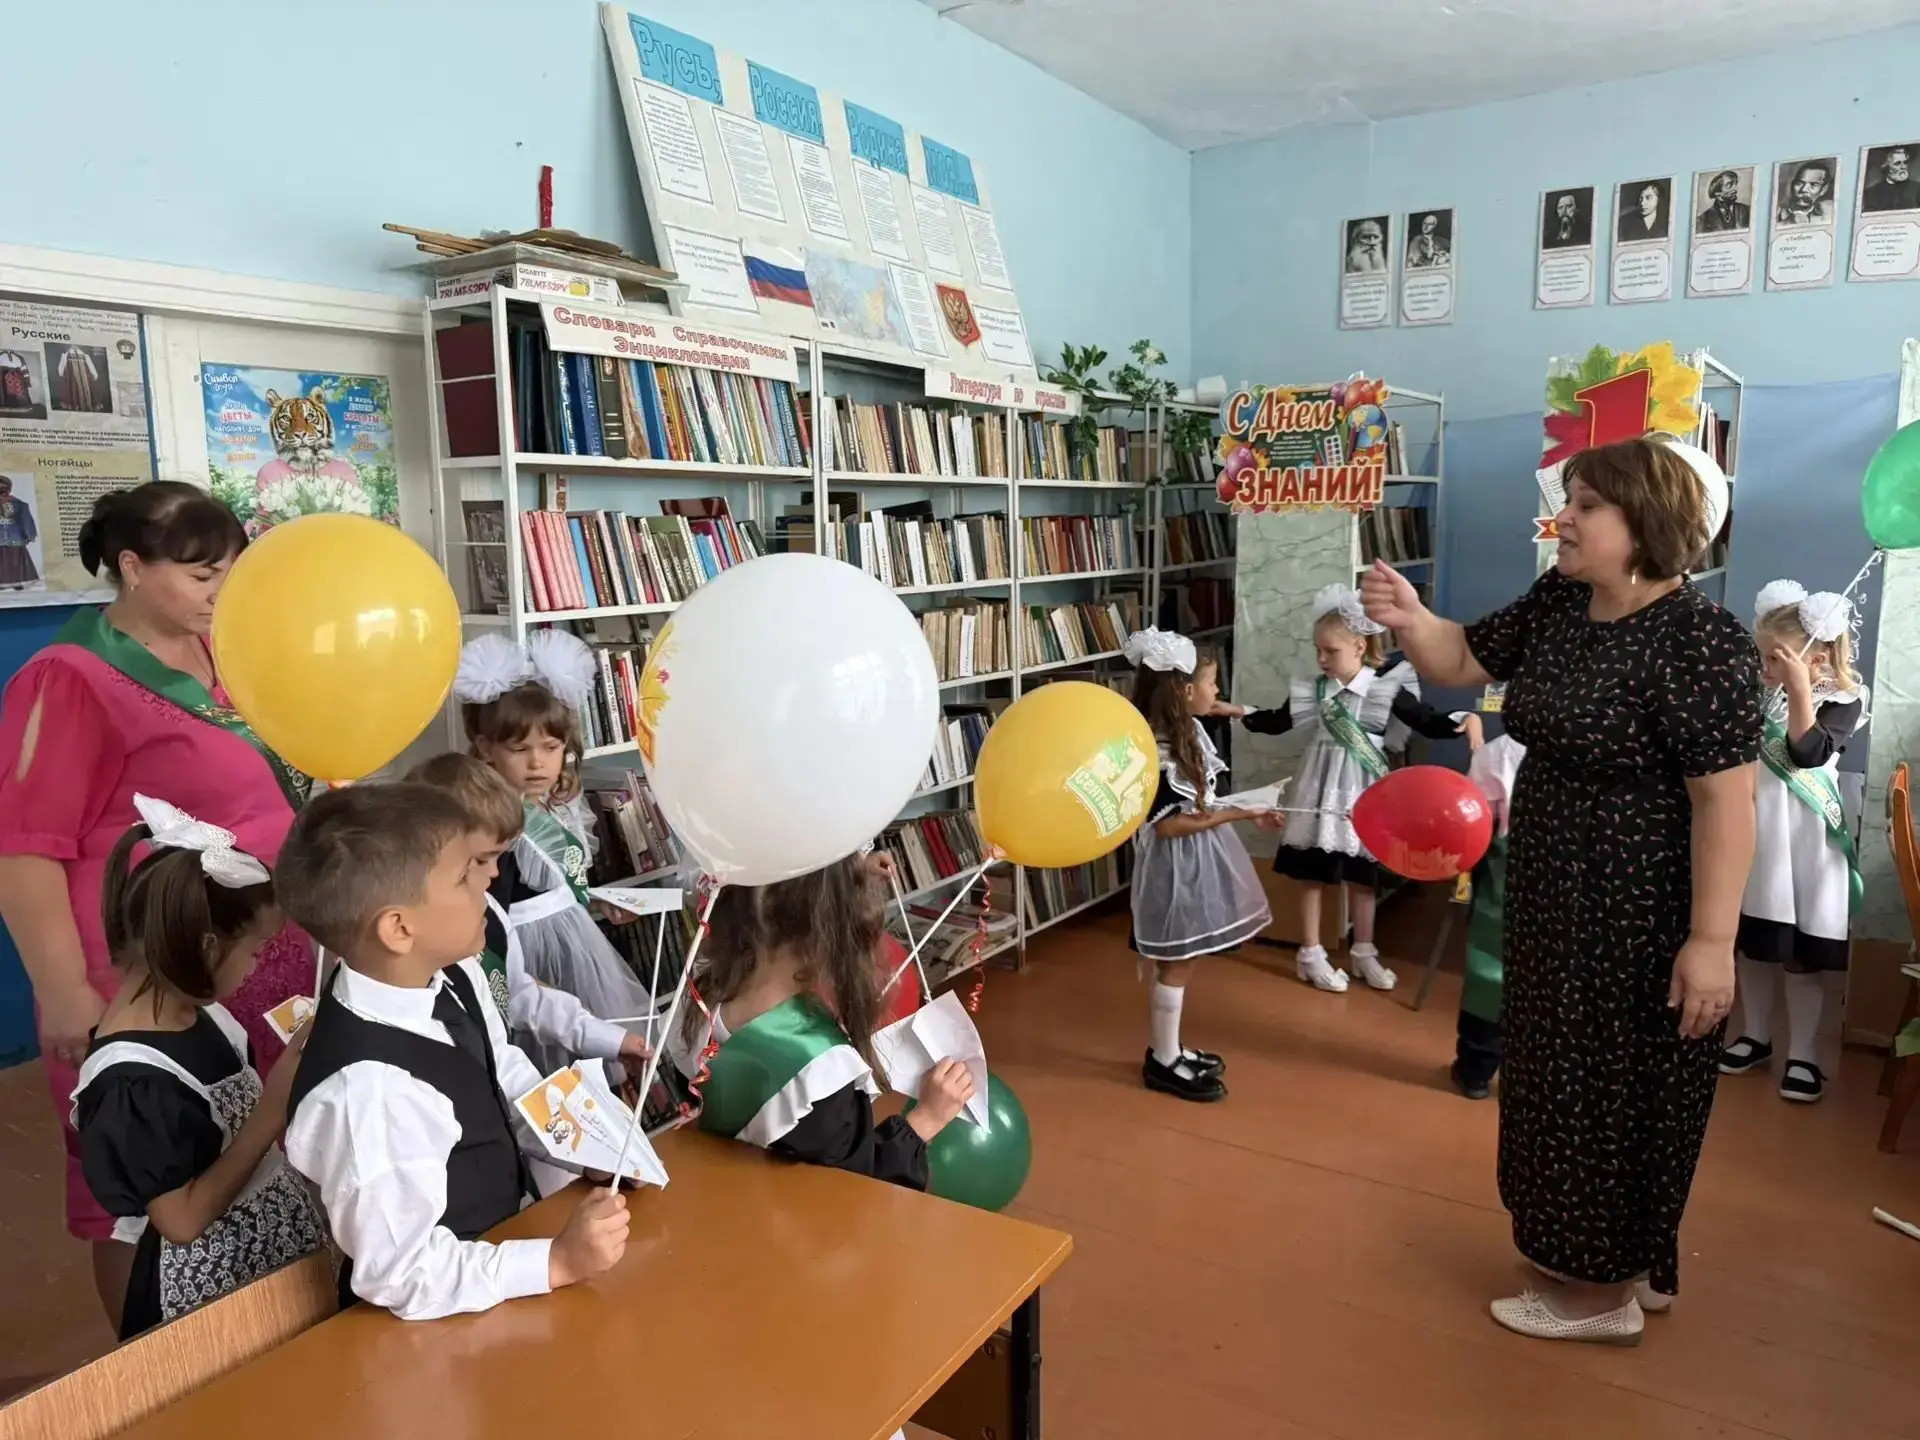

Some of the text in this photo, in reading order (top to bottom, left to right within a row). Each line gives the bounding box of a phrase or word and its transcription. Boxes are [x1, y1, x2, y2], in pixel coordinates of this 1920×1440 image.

[519, 267, 547, 277] GIGABYTE
[11, 326, 71, 341] Русские
[553, 306, 788, 361] Словари Справочники
[613, 336, 750, 370] Энциклопедии
[204, 373, 239, 385] Символ
[949, 371, 1002, 403] Литература
[221, 412, 253, 422] ЦВЕТЫ
[1229, 390, 1336, 440] С Днем
[37, 458, 94, 469] Ногайцы
[1237, 457, 1385, 504] ЗНАНИЙ!
